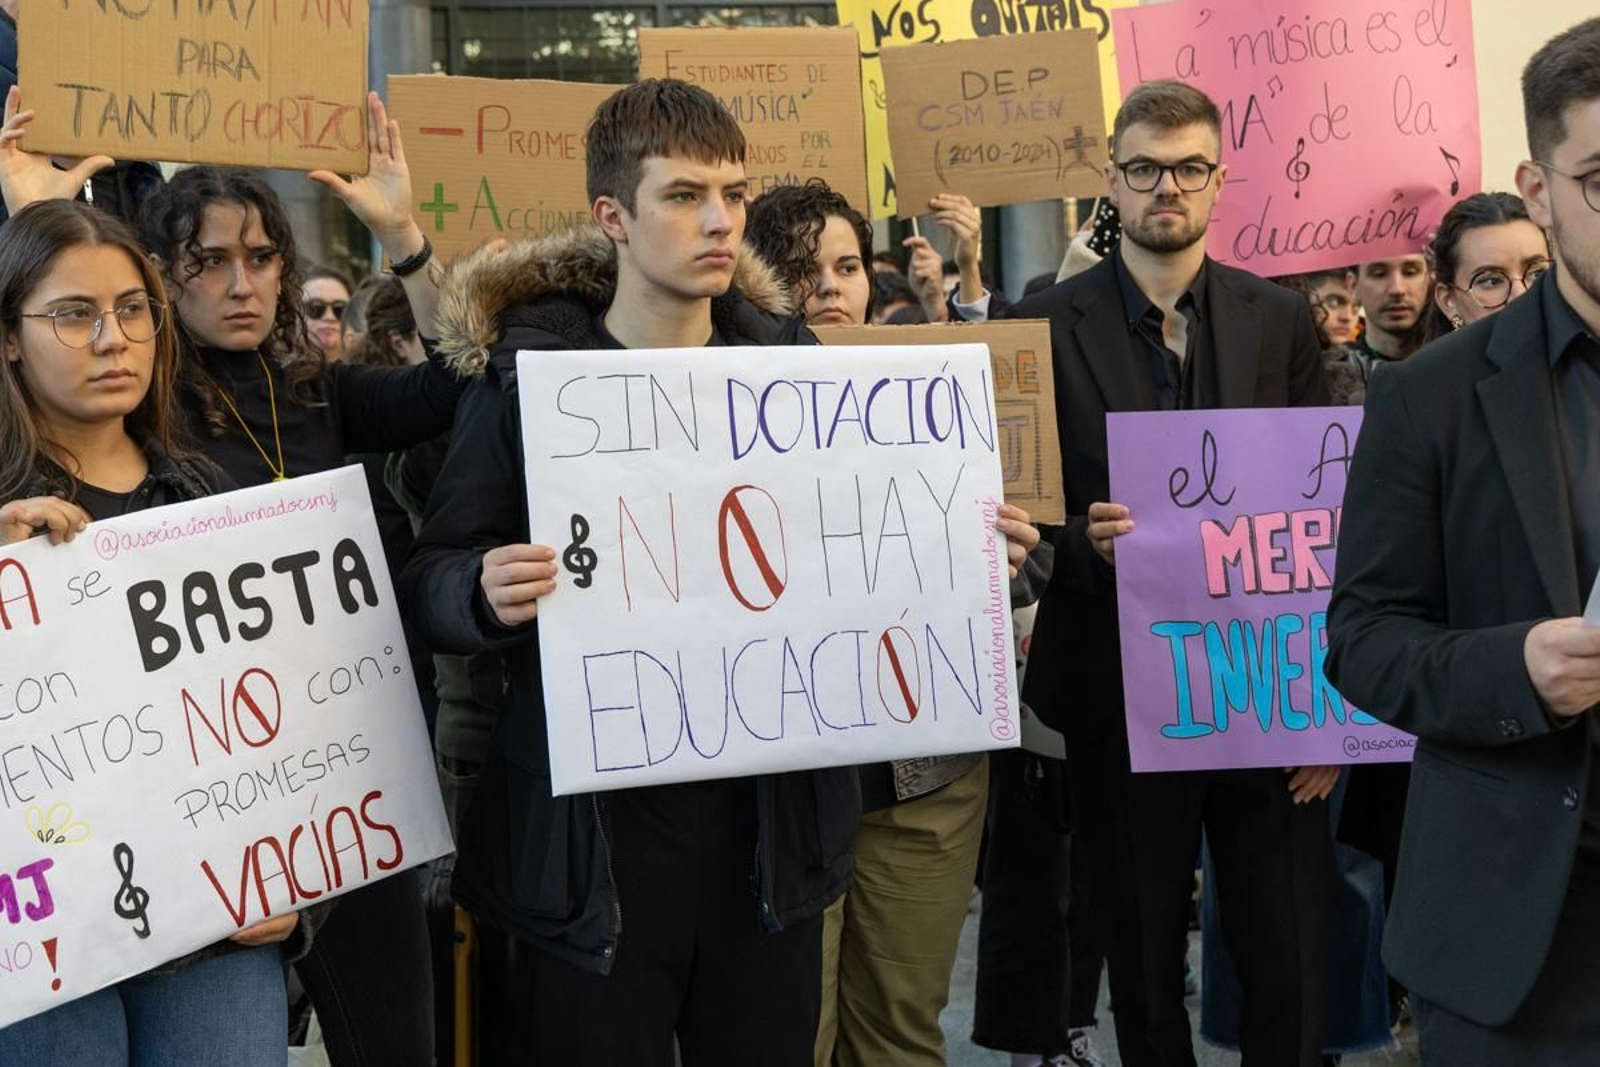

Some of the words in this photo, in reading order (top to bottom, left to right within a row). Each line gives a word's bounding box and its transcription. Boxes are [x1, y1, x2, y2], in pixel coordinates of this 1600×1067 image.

[177, 38, 261, 82] PARA
[664, 49, 789, 83] ESTUDIANTES
[806, 63, 830, 84] DE
[1228, 15, 1354, 71] música
[1365, 12, 1402, 54] es
[1414, 0, 1454, 47] el
[54, 82, 212, 143] TANTO
[223, 95, 365, 151] CHORIZO
[747, 143, 788, 166] ADOS
[800, 130, 833, 150] POR
[916, 103, 984, 132] CSM
[1308, 81, 1352, 145] de
[1393, 74, 1438, 135] la
[801, 153, 830, 169] EL
[1212, 176, 1430, 262] ducación
[550, 370, 700, 459] SIN
[726, 360, 995, 461] DOTACIÓN
[1168, 428, 1237, 508] el
[1301, 422, 1353, 500] A
[816, 463, 966, 597] HAY
[1200, 507, 1344, 598] MER
[67, 570, 112, 606] se
[126, 538, 379, 673] BASTA
[582, 608, 983, 772] EDUCACIÓN
[1150, 610, 1381, 739] INVER
[0, 704, 164, 809] ENTOS
[181, 667, 282, 766] NO
[174, 733, 371, 829] PROMESAS
[1343, 735, 1415, 758] @asociac
[200, 790, 404, 929] VACÍAS
